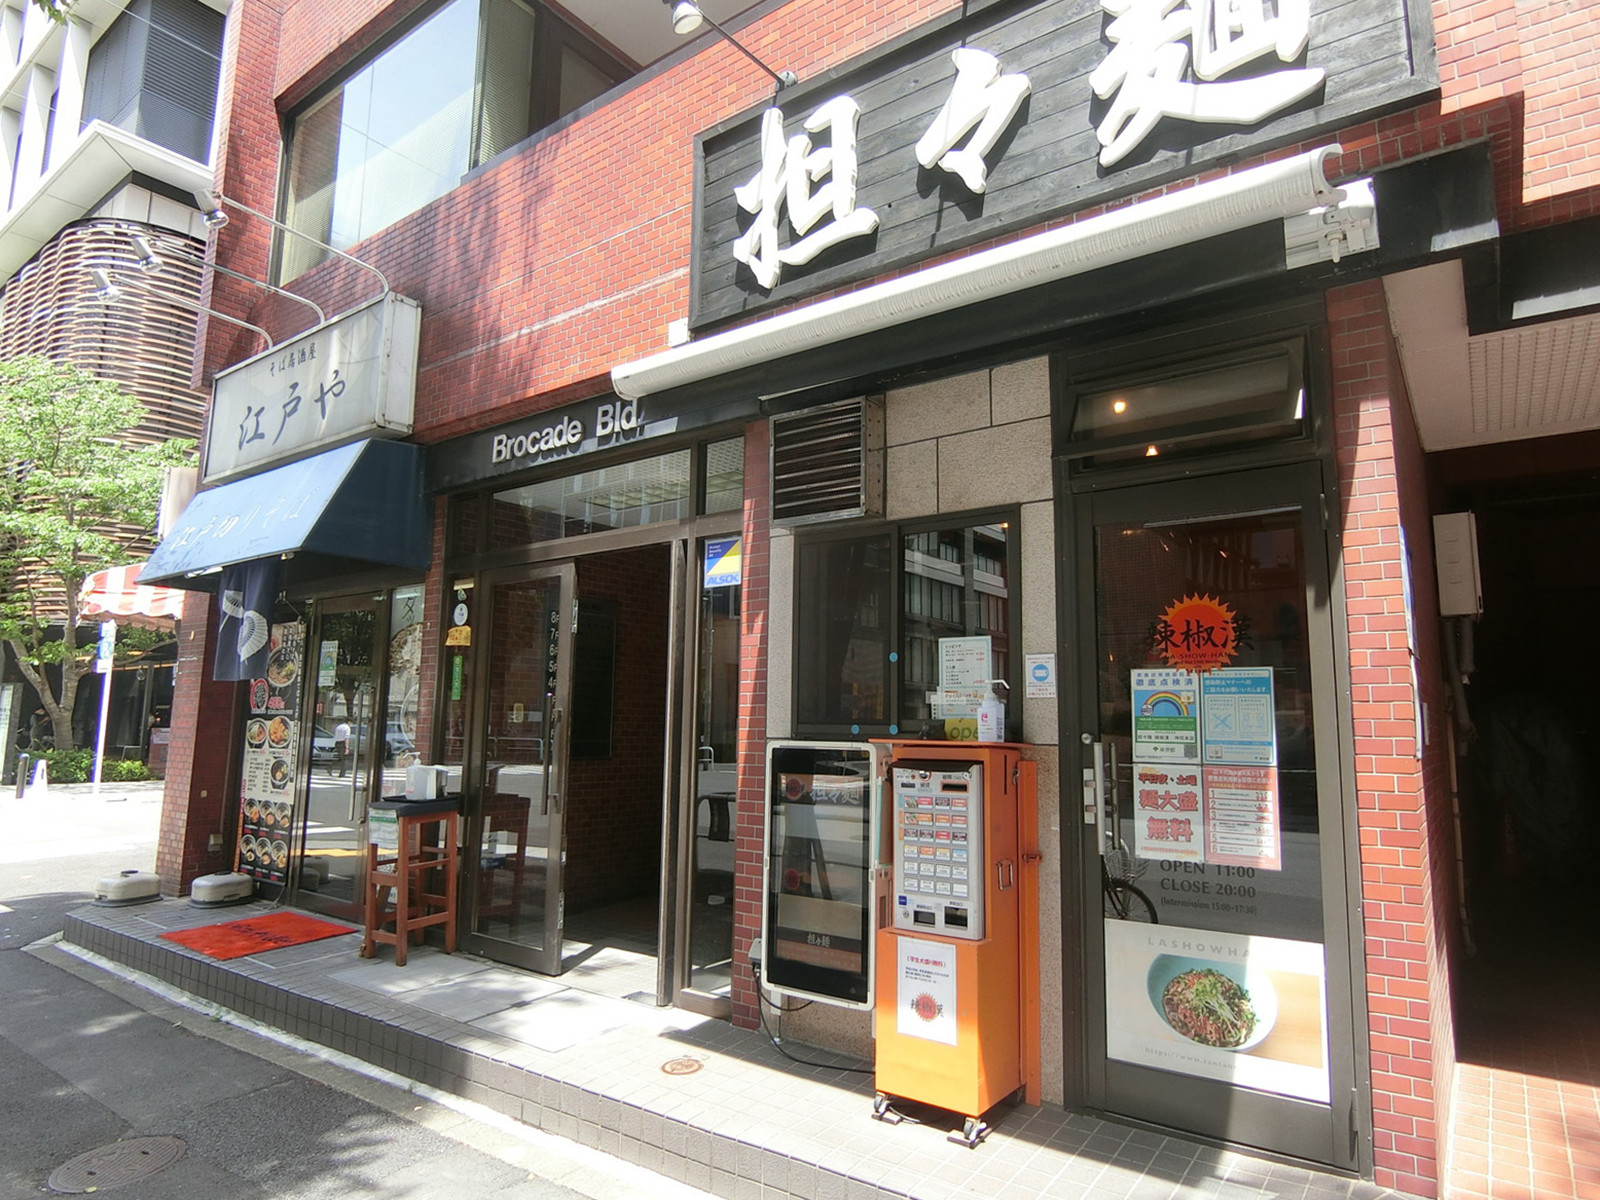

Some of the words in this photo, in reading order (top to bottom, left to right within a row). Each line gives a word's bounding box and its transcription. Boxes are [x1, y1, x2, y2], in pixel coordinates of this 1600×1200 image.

[733, 0, 1325, 288] 担々麺
[270, 342, 316, 377] そば居酒屋
[239, 369, 345, 451] 江戸や
[492, 416, 584, 464] Brocade
[706, 574, 740, 586] ALSOK
[1138, 788, 1199, 812] 麺大盛
[1147, 816, 1194, 843] 無料
[1160, 860, 1205, 875] OPEN
[1215, 864, 1255, 879] 11:00
[1160, 877, 1210, 894] CLOSE
[1215, 883, 1256, 898] 20:00
